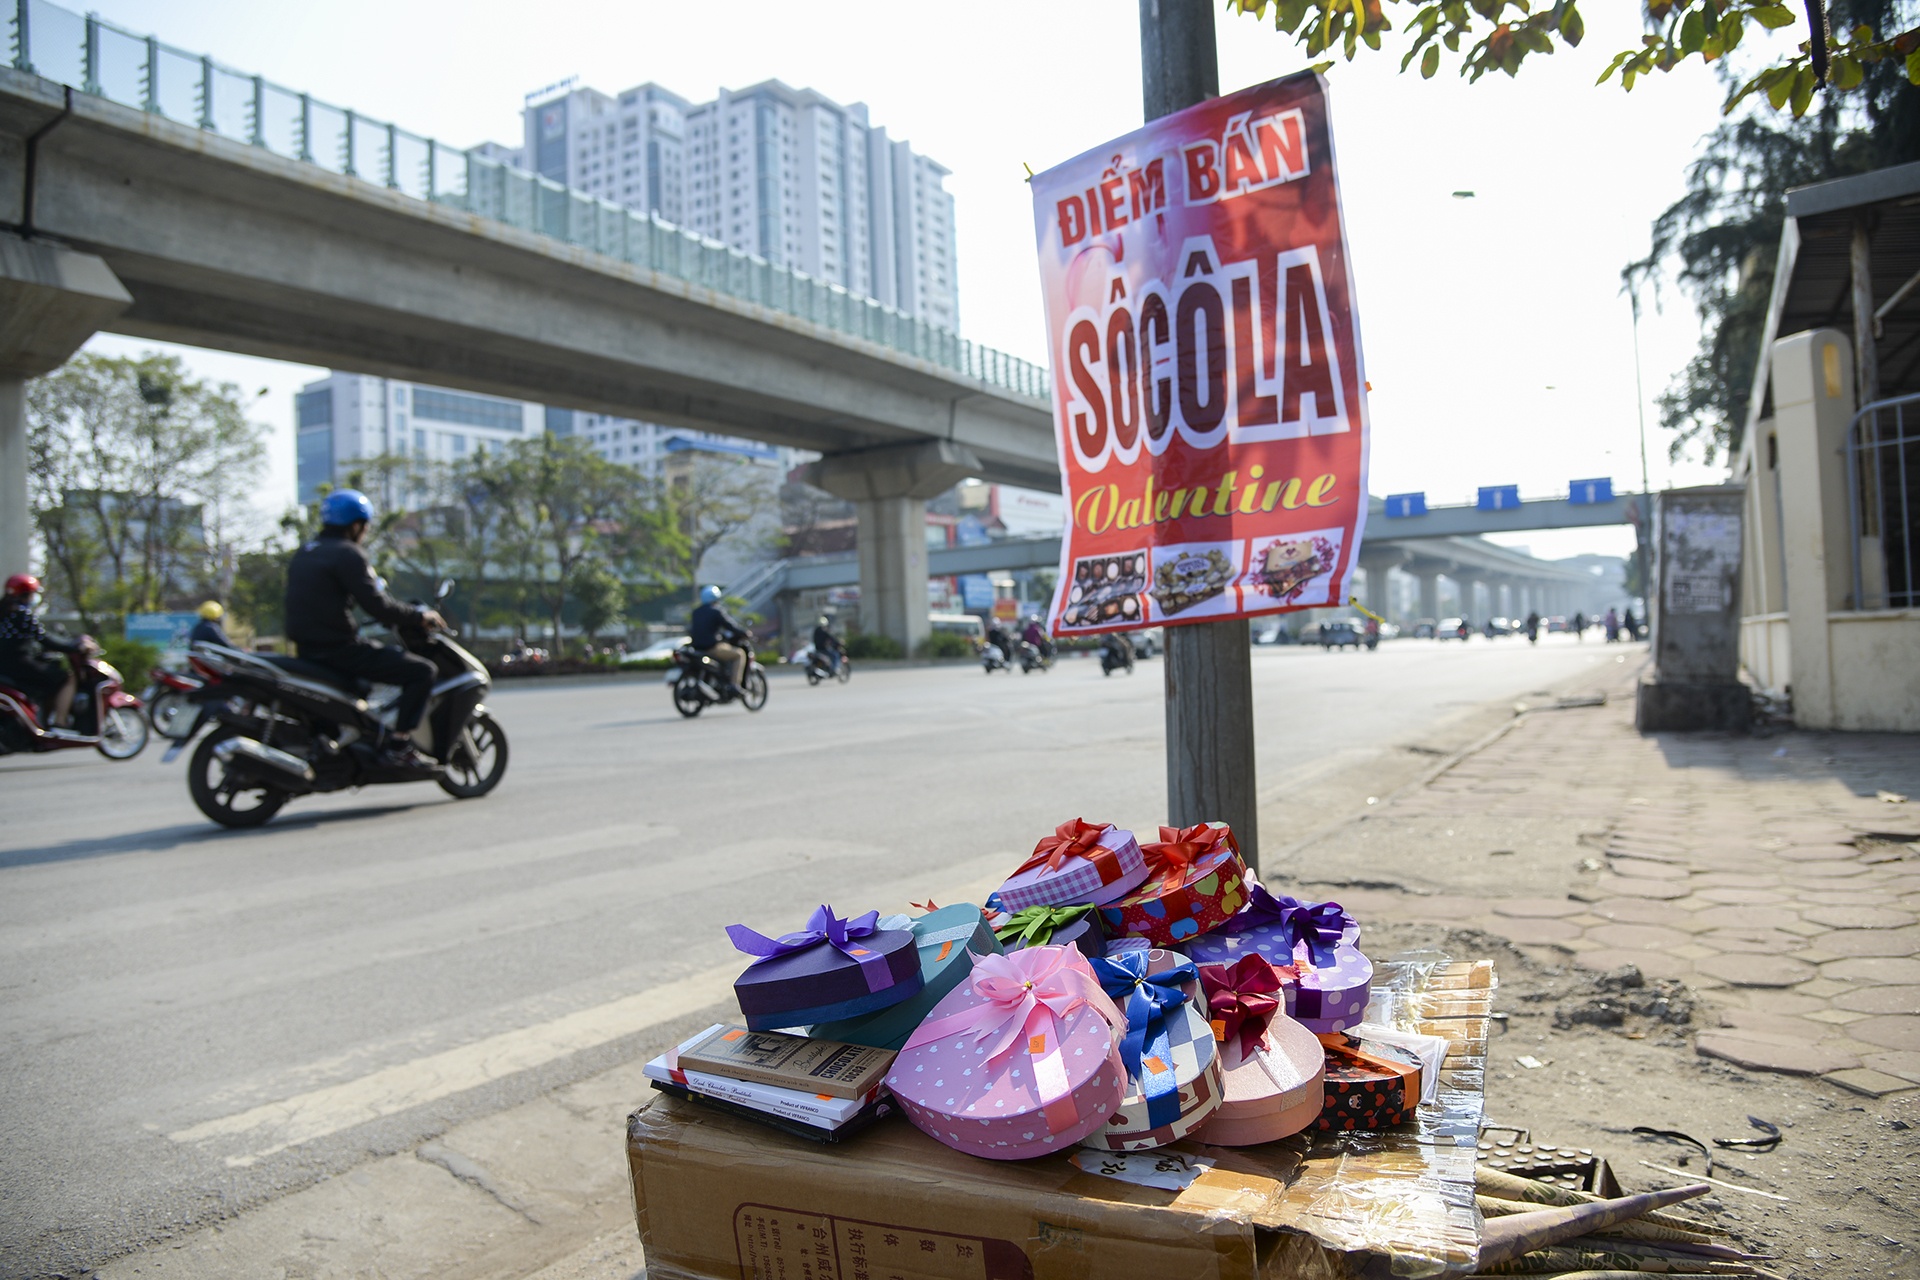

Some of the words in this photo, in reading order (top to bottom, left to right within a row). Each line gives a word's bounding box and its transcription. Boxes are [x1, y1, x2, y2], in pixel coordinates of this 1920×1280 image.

[1057, 153, 1167, 248] ĐIỂM
[1184, 111, 1308, 205] BÁN
[1066, 244, 1342, 464] SÔCÔLA
[1075, 465, 1339, 535] Valentine
[820, 1046, 867, 1079] CHOCOLATE
[773, 1107, 787, 1116] Product
[780, 1100, 794, 1109] Product
